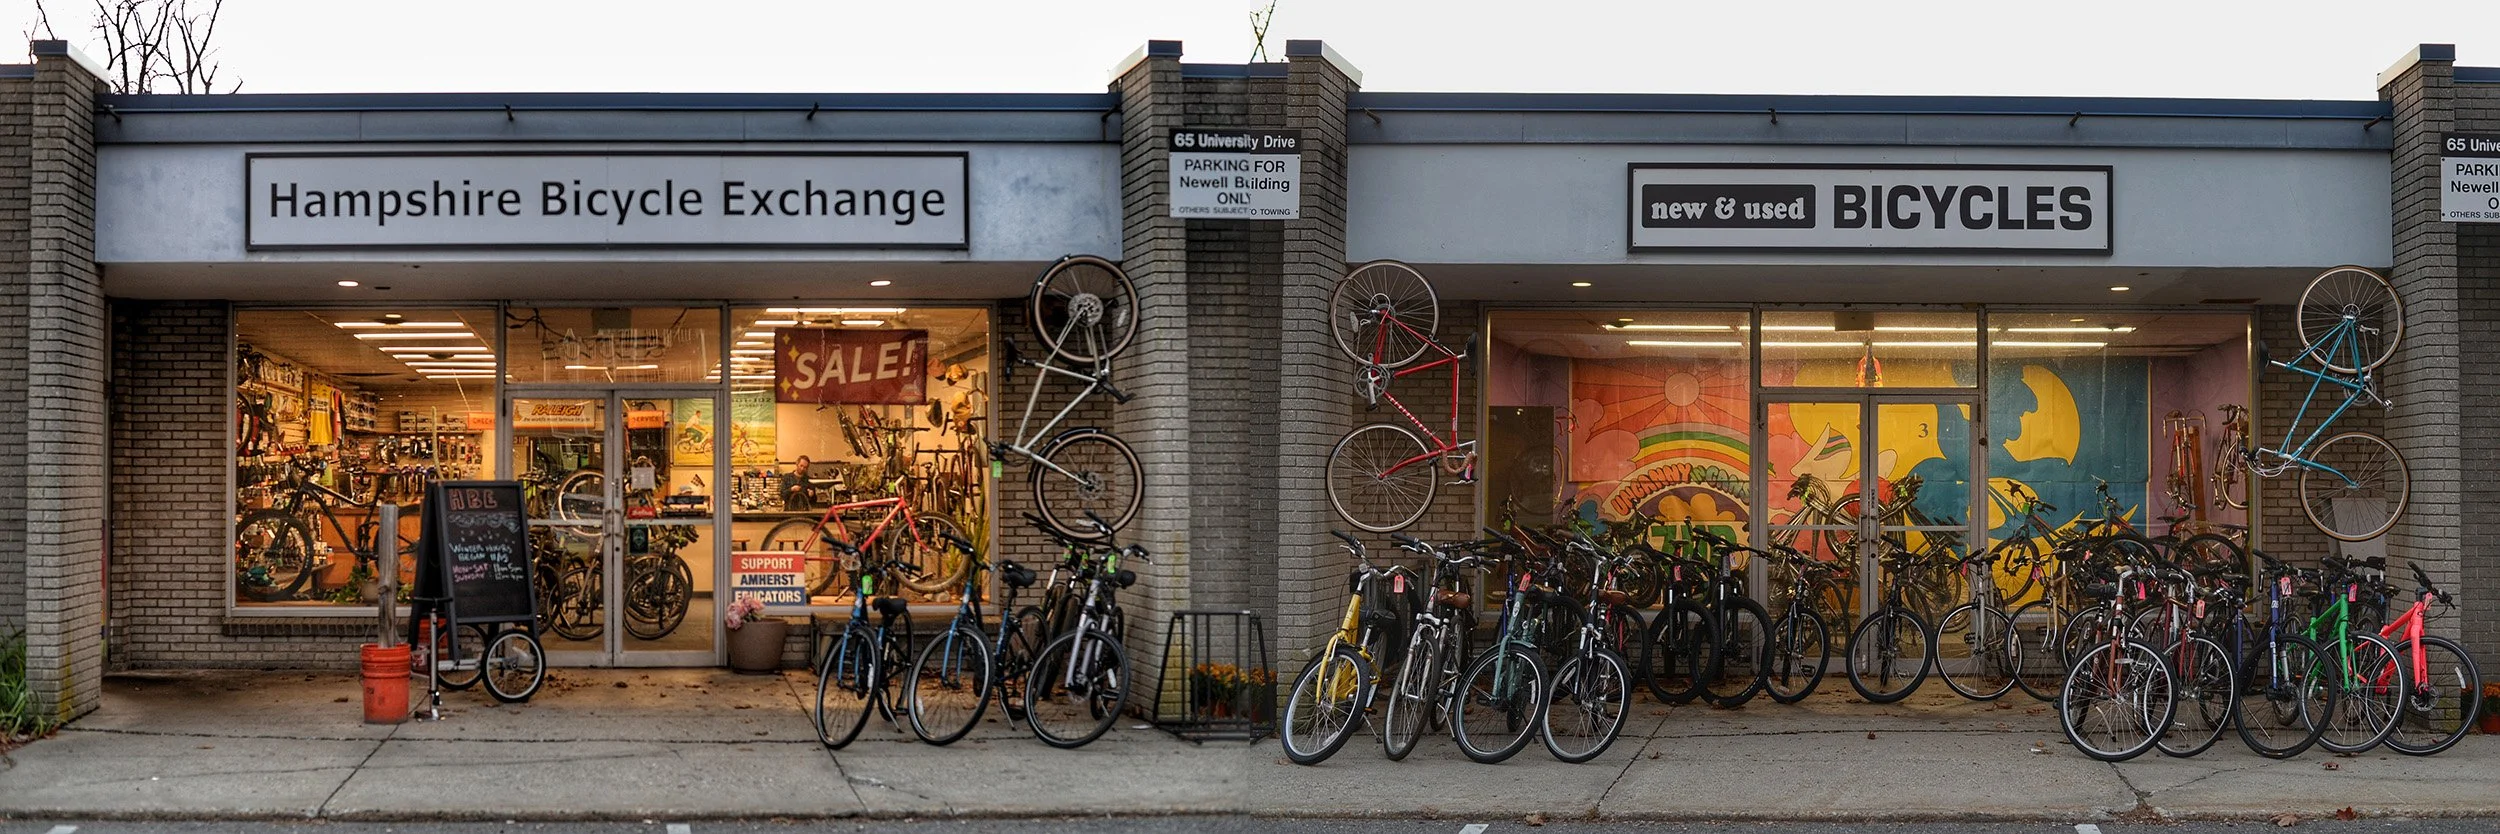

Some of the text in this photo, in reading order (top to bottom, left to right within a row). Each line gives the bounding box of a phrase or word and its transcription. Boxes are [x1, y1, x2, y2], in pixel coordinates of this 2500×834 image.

[1174, 133, 1296, 150] 65 University Drive
[2446, 138, 2466, 151] 65
[1184, 159, 1285, 173] PARKING FOR
[1180, 176, 1290, 192] Newell Building
[2451, 181, 2499, 193] Newell
[270, 179, 945, 227] Hampshire Bicycle Exchange
[1651, 185, 2093, 231] new & used BICYCLES
[1178, 206, 1291, 216] OTHERS SUBJECT O TOWING
[2450, 211, 2480, 219] OTHERS
[793, 339, 916, 390] SALE!
[531, 404, 585, 416] RALEIGH
[1918, 423, 1929, 438] 3
[1611, 463, 1693, 516] UNCANNY
[449, 488, 497, 511] HBE
[741, 557, 794, 570] SUPPORT
[740, 574, 795, 586] AMHERST
